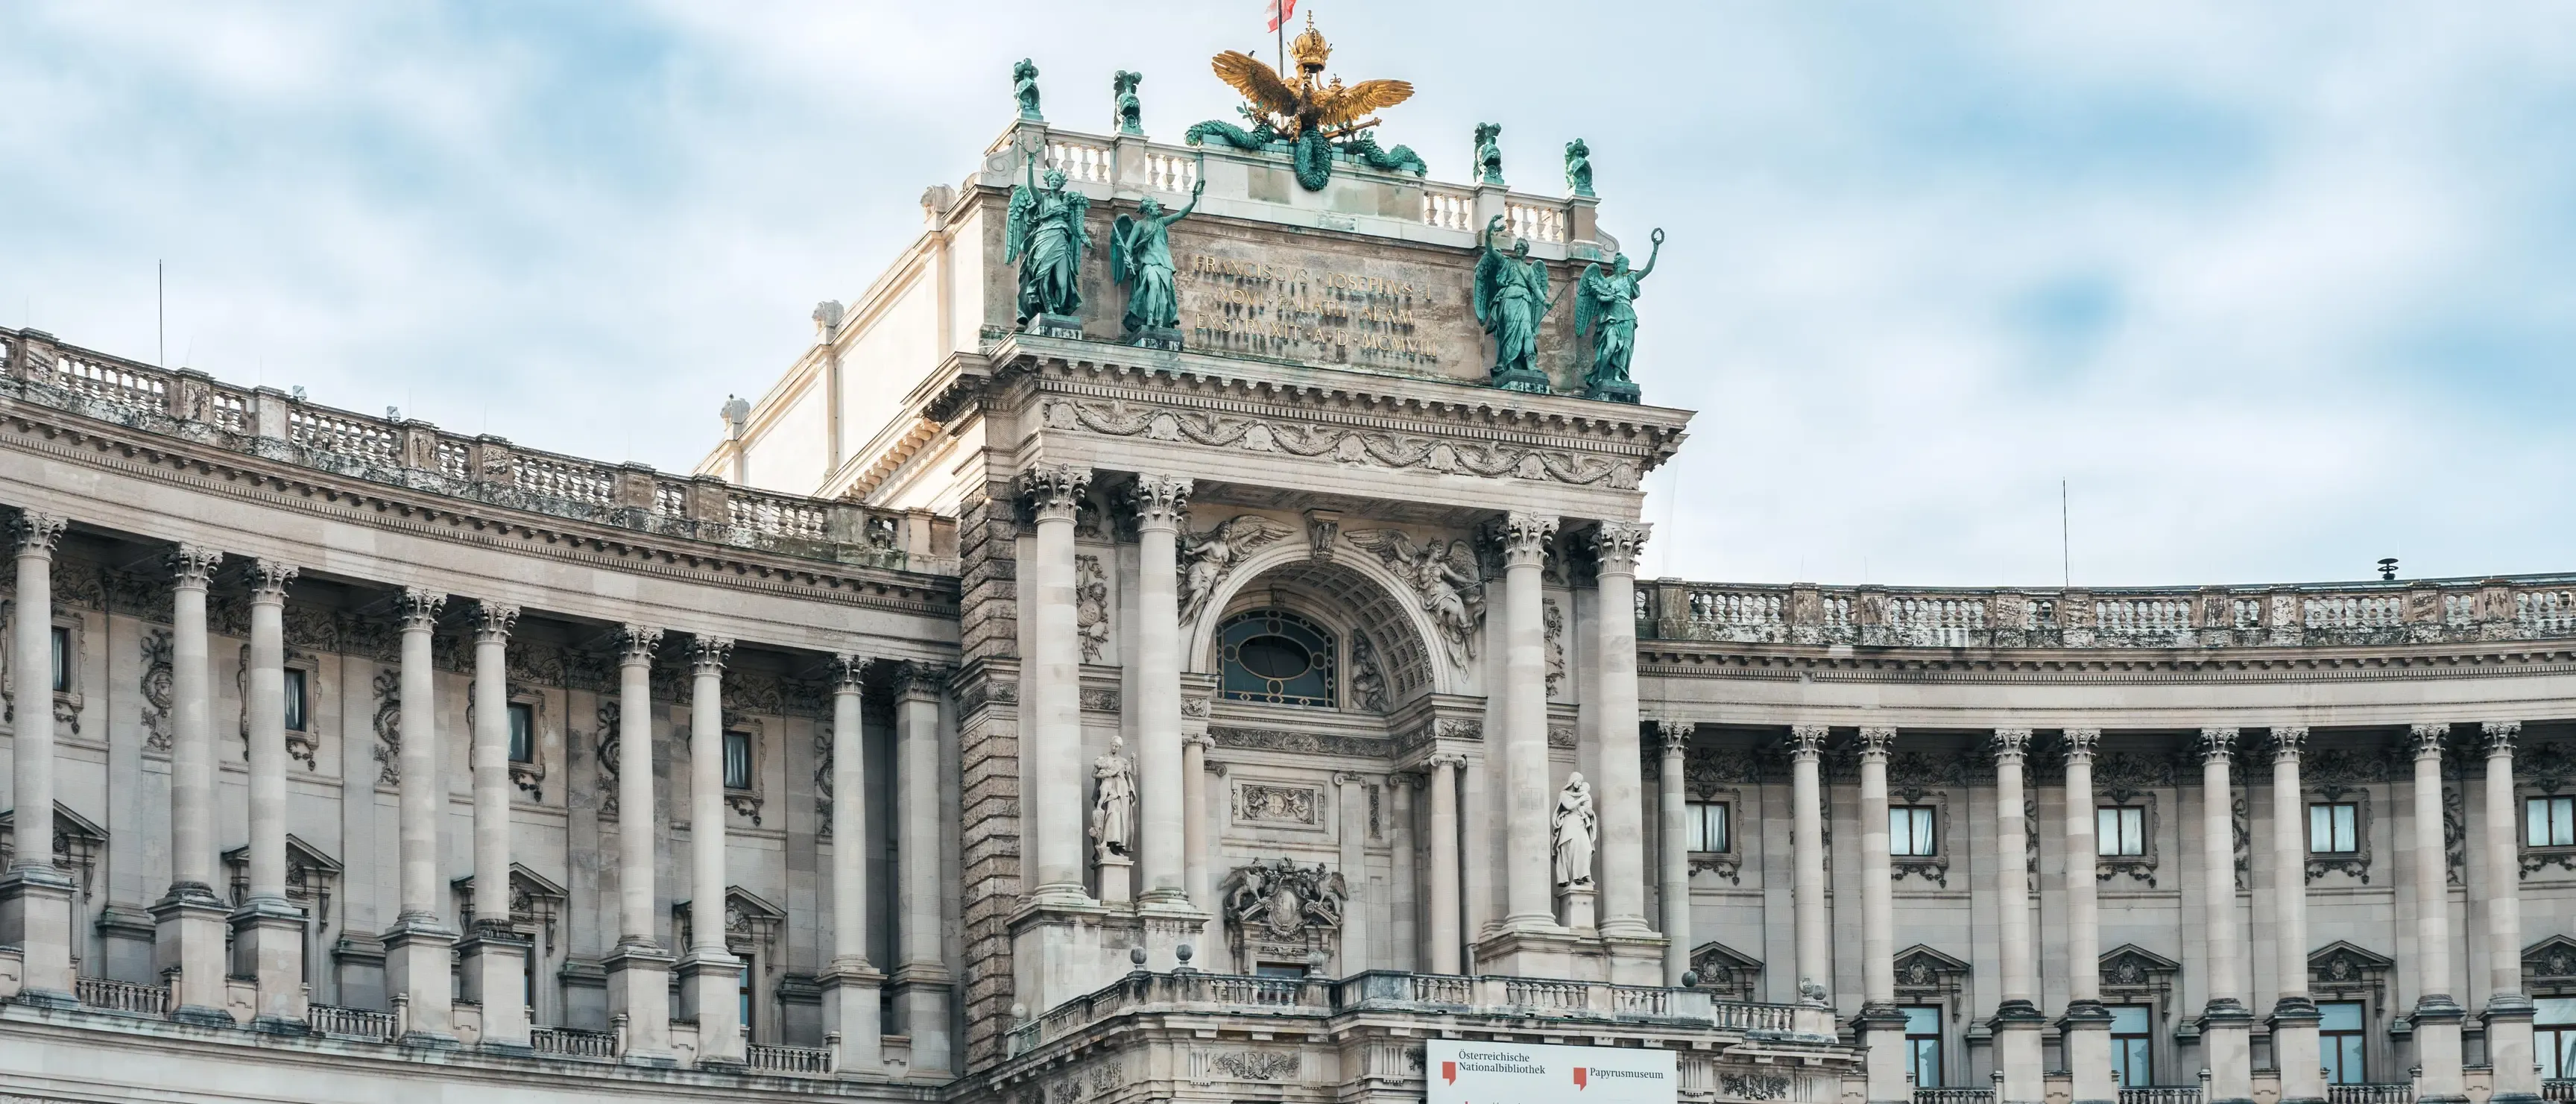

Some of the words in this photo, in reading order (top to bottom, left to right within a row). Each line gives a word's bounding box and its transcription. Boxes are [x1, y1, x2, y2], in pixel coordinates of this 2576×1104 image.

[1195, 256, 1307, 283] FRANCISCVS
[1328, 273, 1413, 297] IOSEPHVS
[1219, 287, 1263, 306] NOVI
[1279, 295, 1346, 317] PALATII
[1362, 306, 1413, 324] ALAM
[1196, 314, 1301, 340] EXSTRVXIT
[1363, 333, 1436, 356] MCMVIII
[1459, 1049, 1530, 1062] Österreichische
[1459, 1062, 1546, 1074] Nationalbibliothek
[1590, 1067, 1664, 1079] Papyrusmuseum
